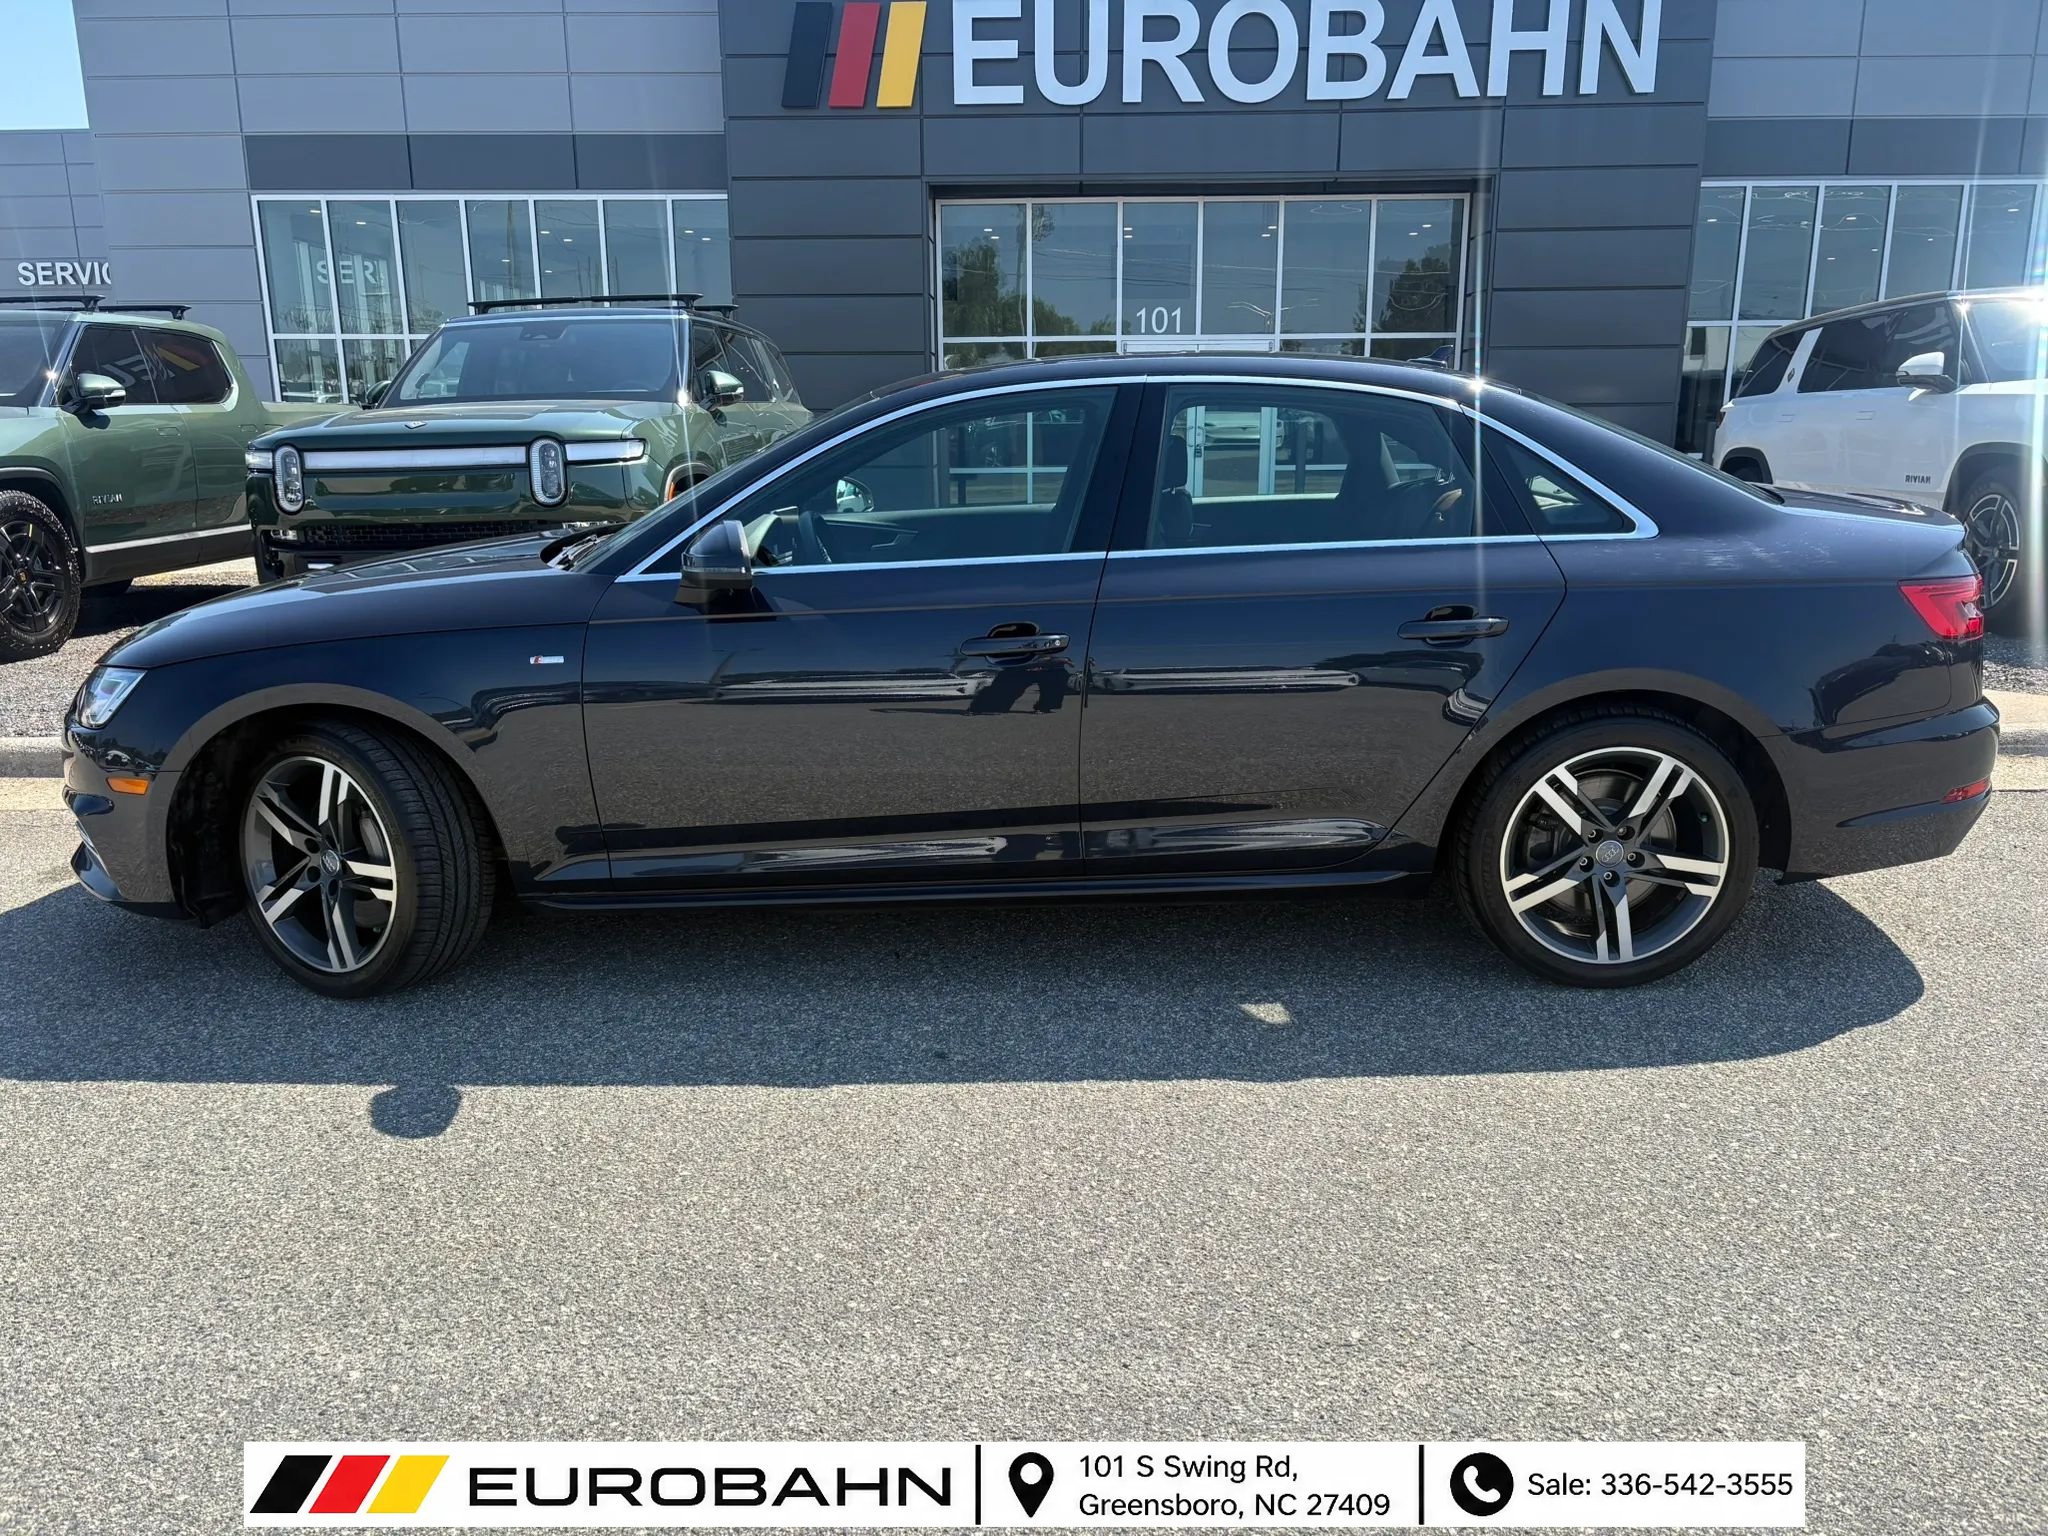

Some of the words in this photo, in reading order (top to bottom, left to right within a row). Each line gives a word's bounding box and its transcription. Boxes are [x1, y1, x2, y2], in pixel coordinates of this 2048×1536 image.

[953, 0, 1661, 106] EUROBAHN
[1136, 306, 1181, 334] 101
[1904, 474, 1931, 484] RIVIAN
